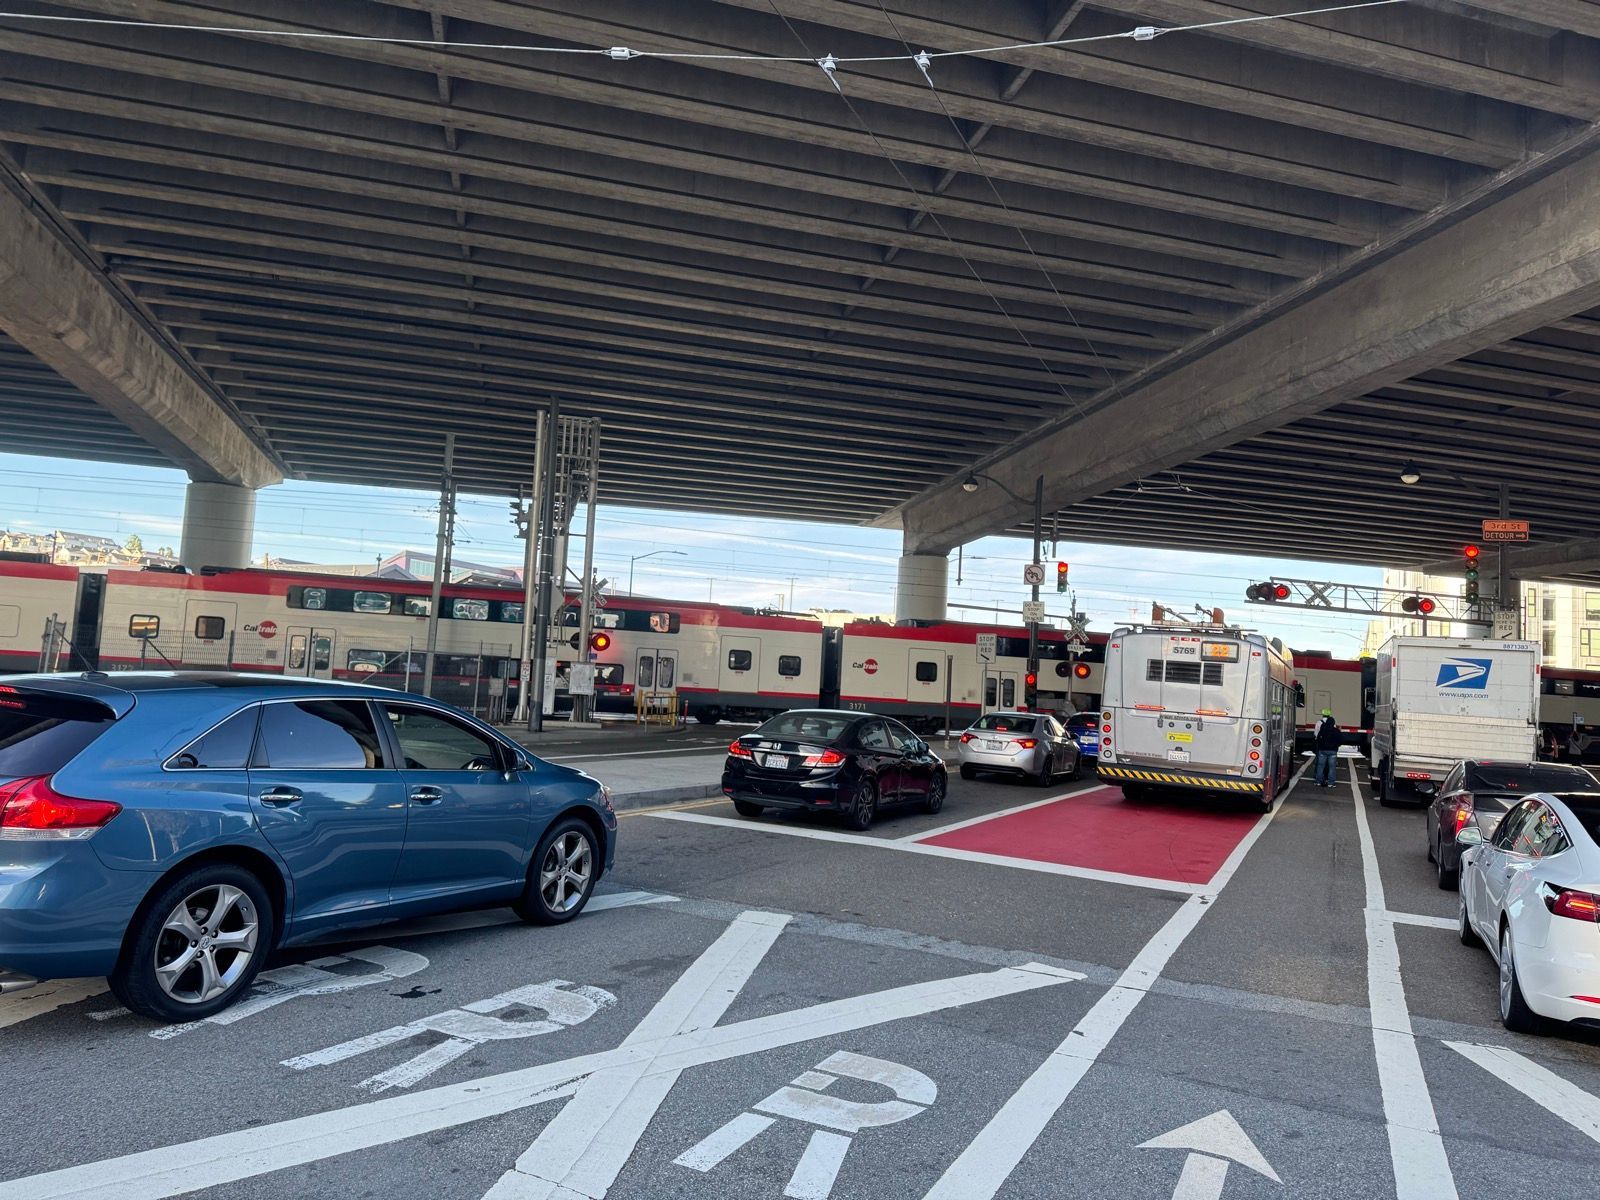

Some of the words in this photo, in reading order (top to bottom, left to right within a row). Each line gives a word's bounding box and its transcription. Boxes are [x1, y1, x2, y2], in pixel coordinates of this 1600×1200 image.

[1173, 646, 1196, 655] 5769
[1211, 643, 1231, 657] 22
[1439, 691, 1489, 700] www.usps.com
[849, 702, 866, 710] 3171
[672, 1050, 938, 1200] R
